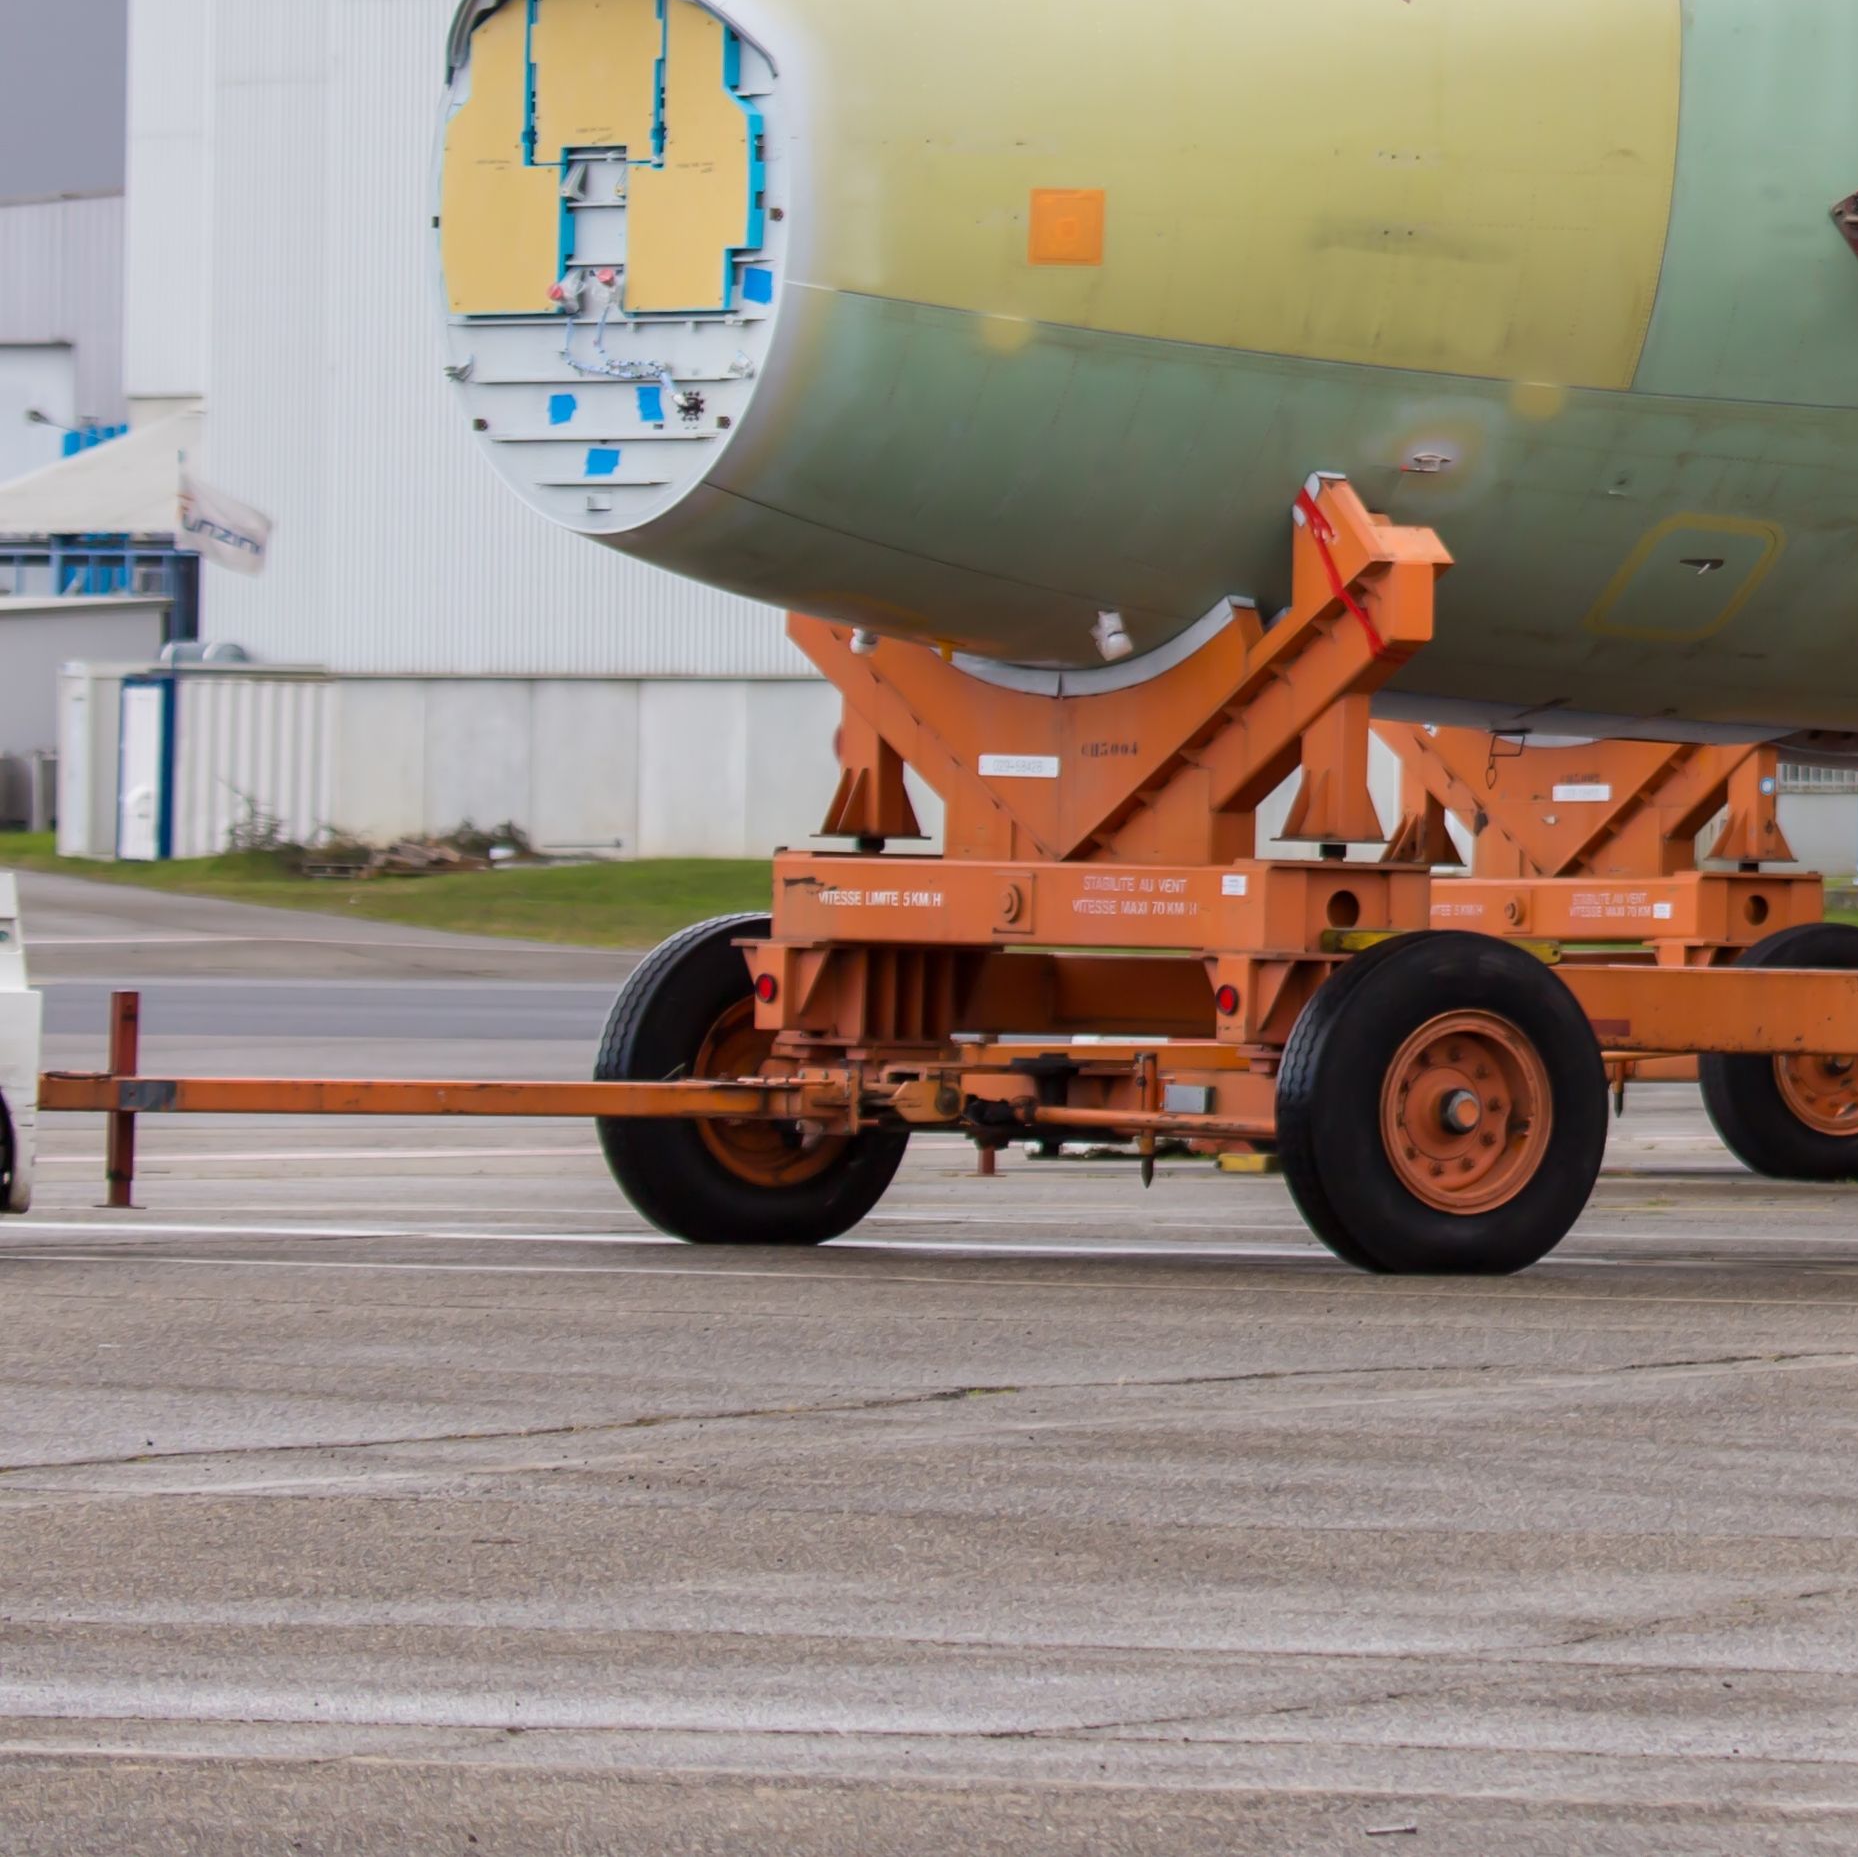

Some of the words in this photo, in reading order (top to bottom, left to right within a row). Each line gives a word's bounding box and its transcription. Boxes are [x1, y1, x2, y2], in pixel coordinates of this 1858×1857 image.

[1083, 875, 1135, 892] STABILITE
[1139, 878, 1153, 892] AU
[1158, 878, 1187, 893] VENT
[818, 890, 862, 905] VITESSE
[865, 891, 898, 906] LIMITE
[903, 892, 910, 906] 5
[1072, 899, 1117, 915] VITESSE
[1120, 900, 1147, 915] MAXI
